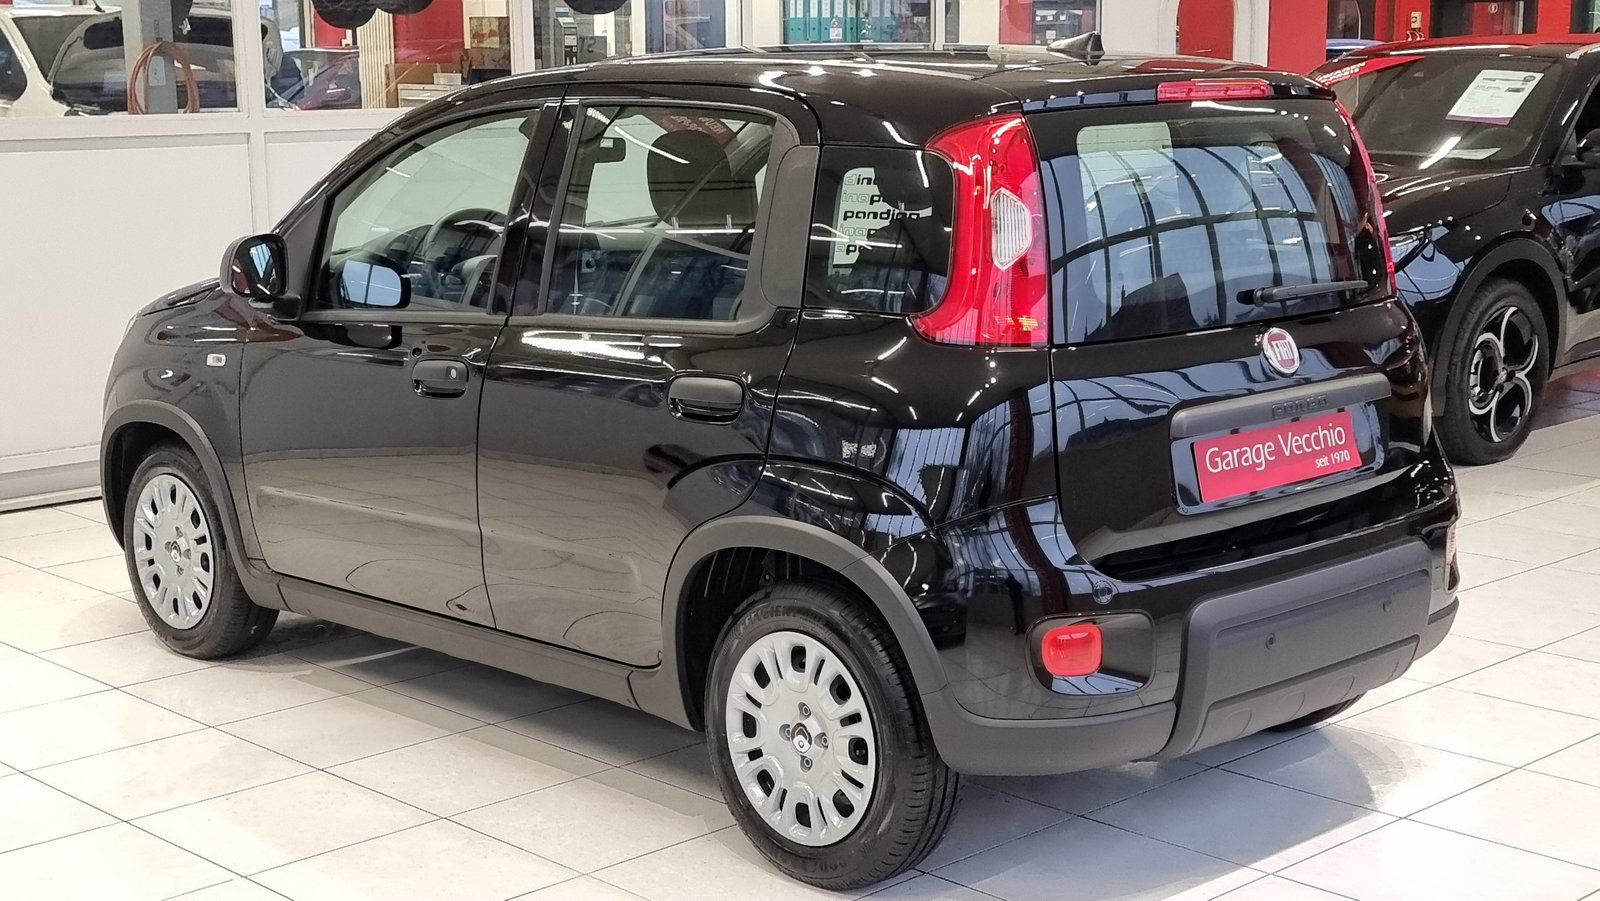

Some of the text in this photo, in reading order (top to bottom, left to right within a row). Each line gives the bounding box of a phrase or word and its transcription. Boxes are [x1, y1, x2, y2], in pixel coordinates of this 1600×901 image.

[842, 208, 920, 220] pandina
[1270, 339, 1296, 361] FIAT
[1205, 423, 1346, 473] Garage Vecchio
[1315, 449, 1351, 469] seit 1970
